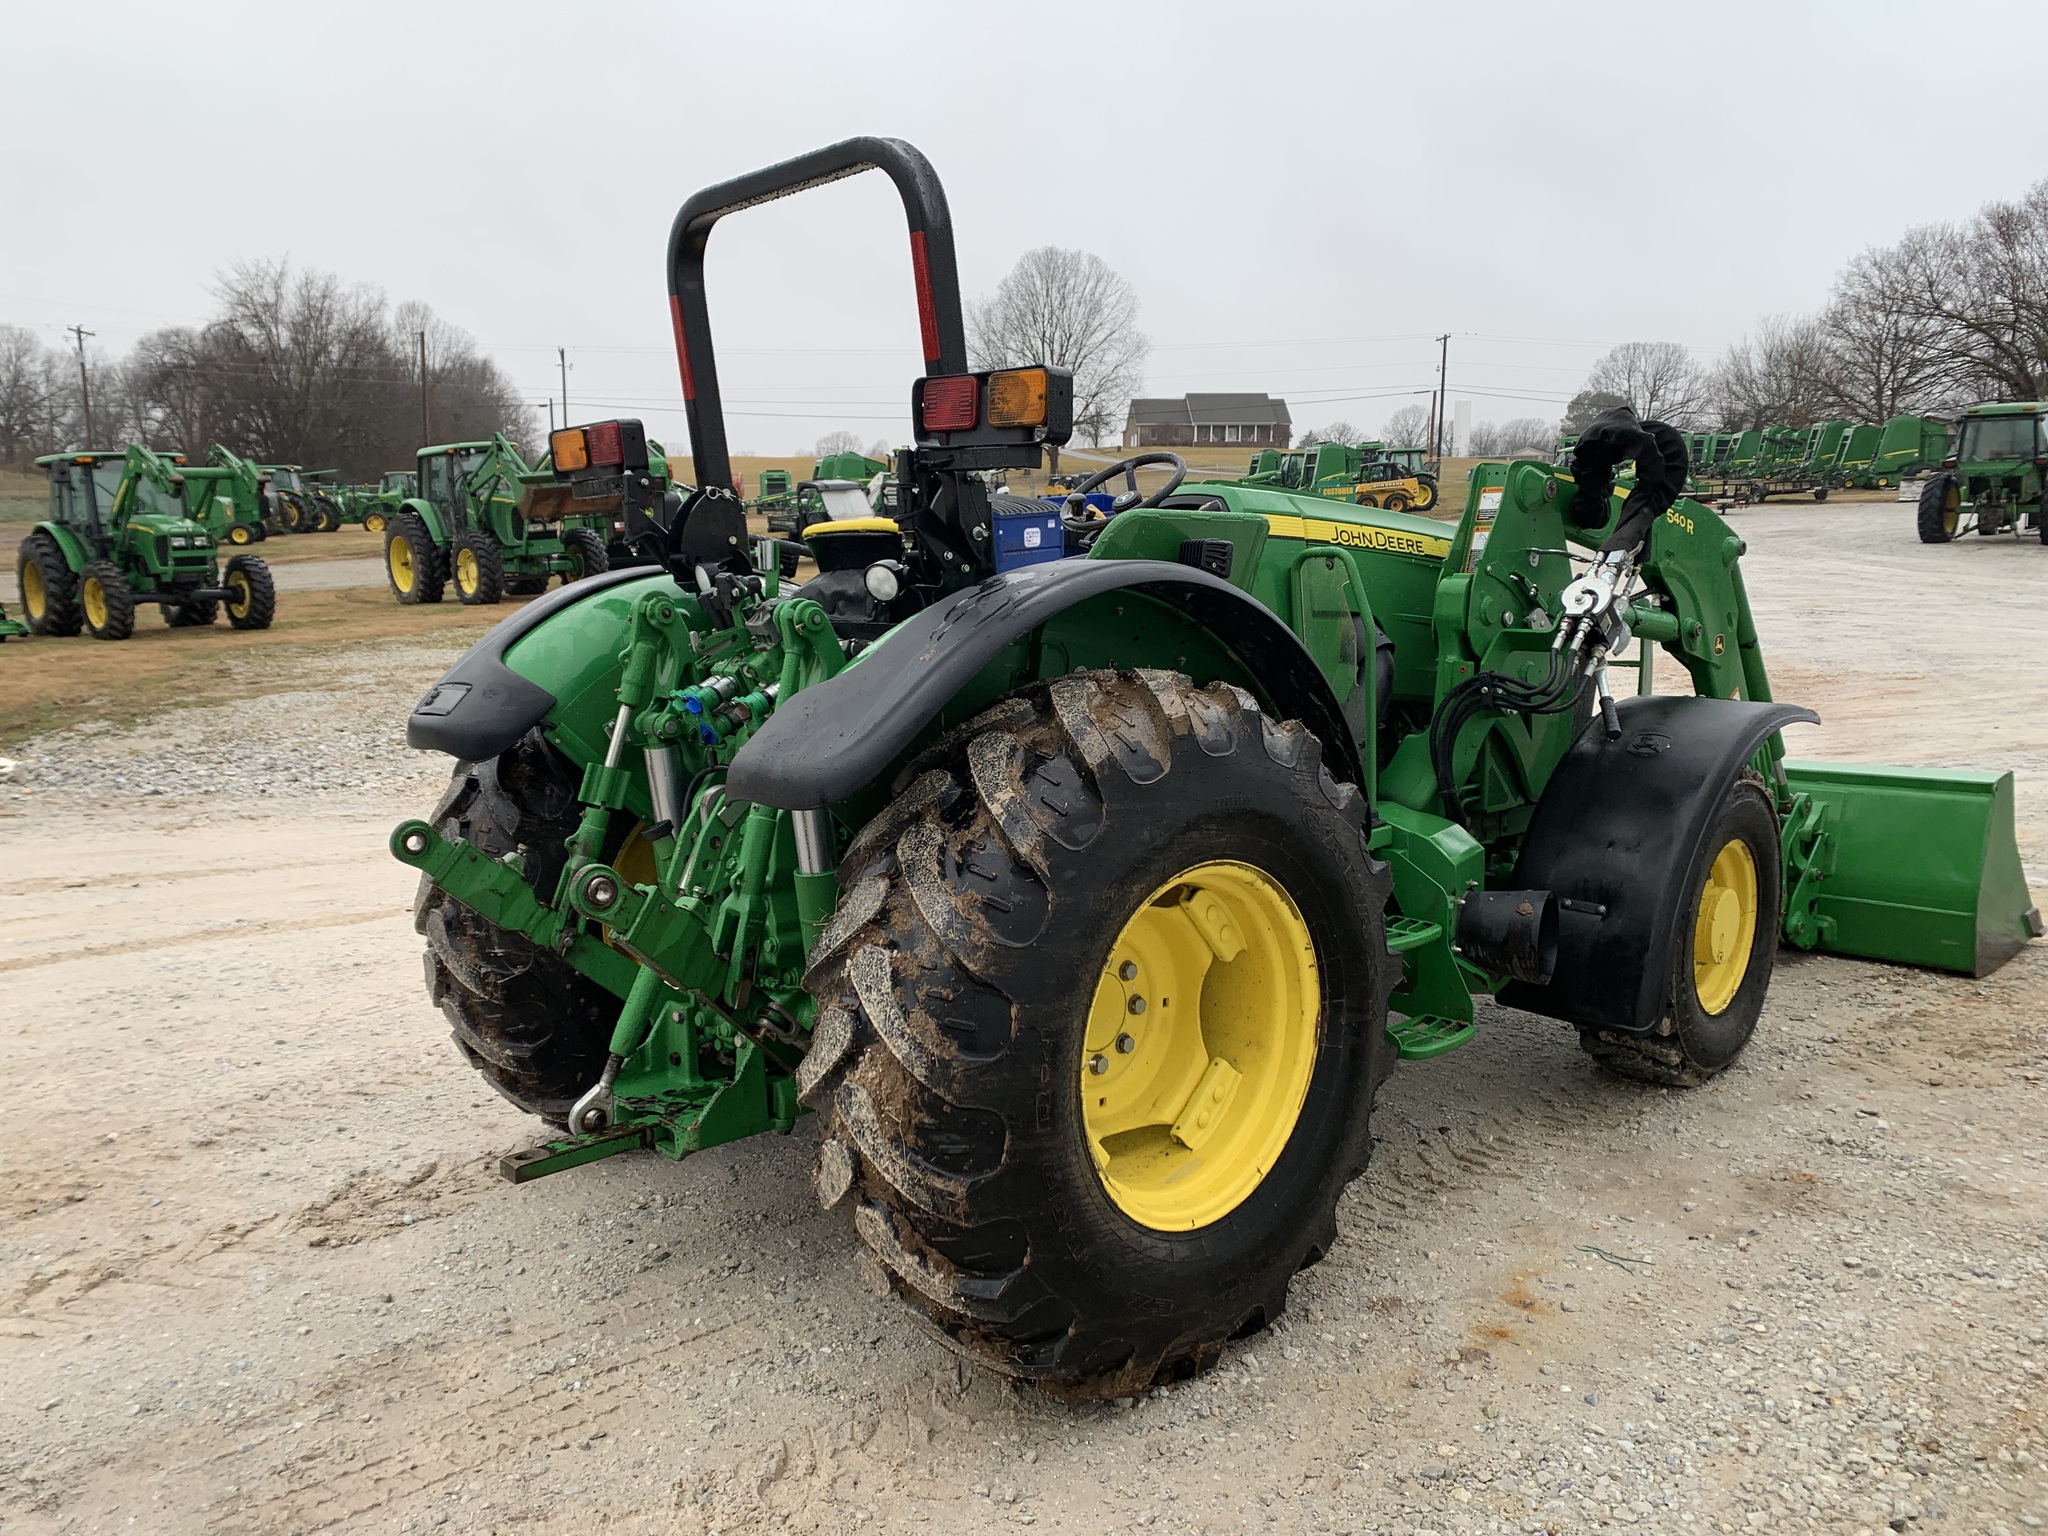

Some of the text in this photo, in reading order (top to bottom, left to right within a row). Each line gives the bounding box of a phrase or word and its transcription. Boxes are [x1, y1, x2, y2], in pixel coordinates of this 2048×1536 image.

[1323, 487, 1354, 496] CUSTOMER
[1666, 508, 1694, 535] 540 R
[1330, 526, 1425, 555] JOHN DEERE
